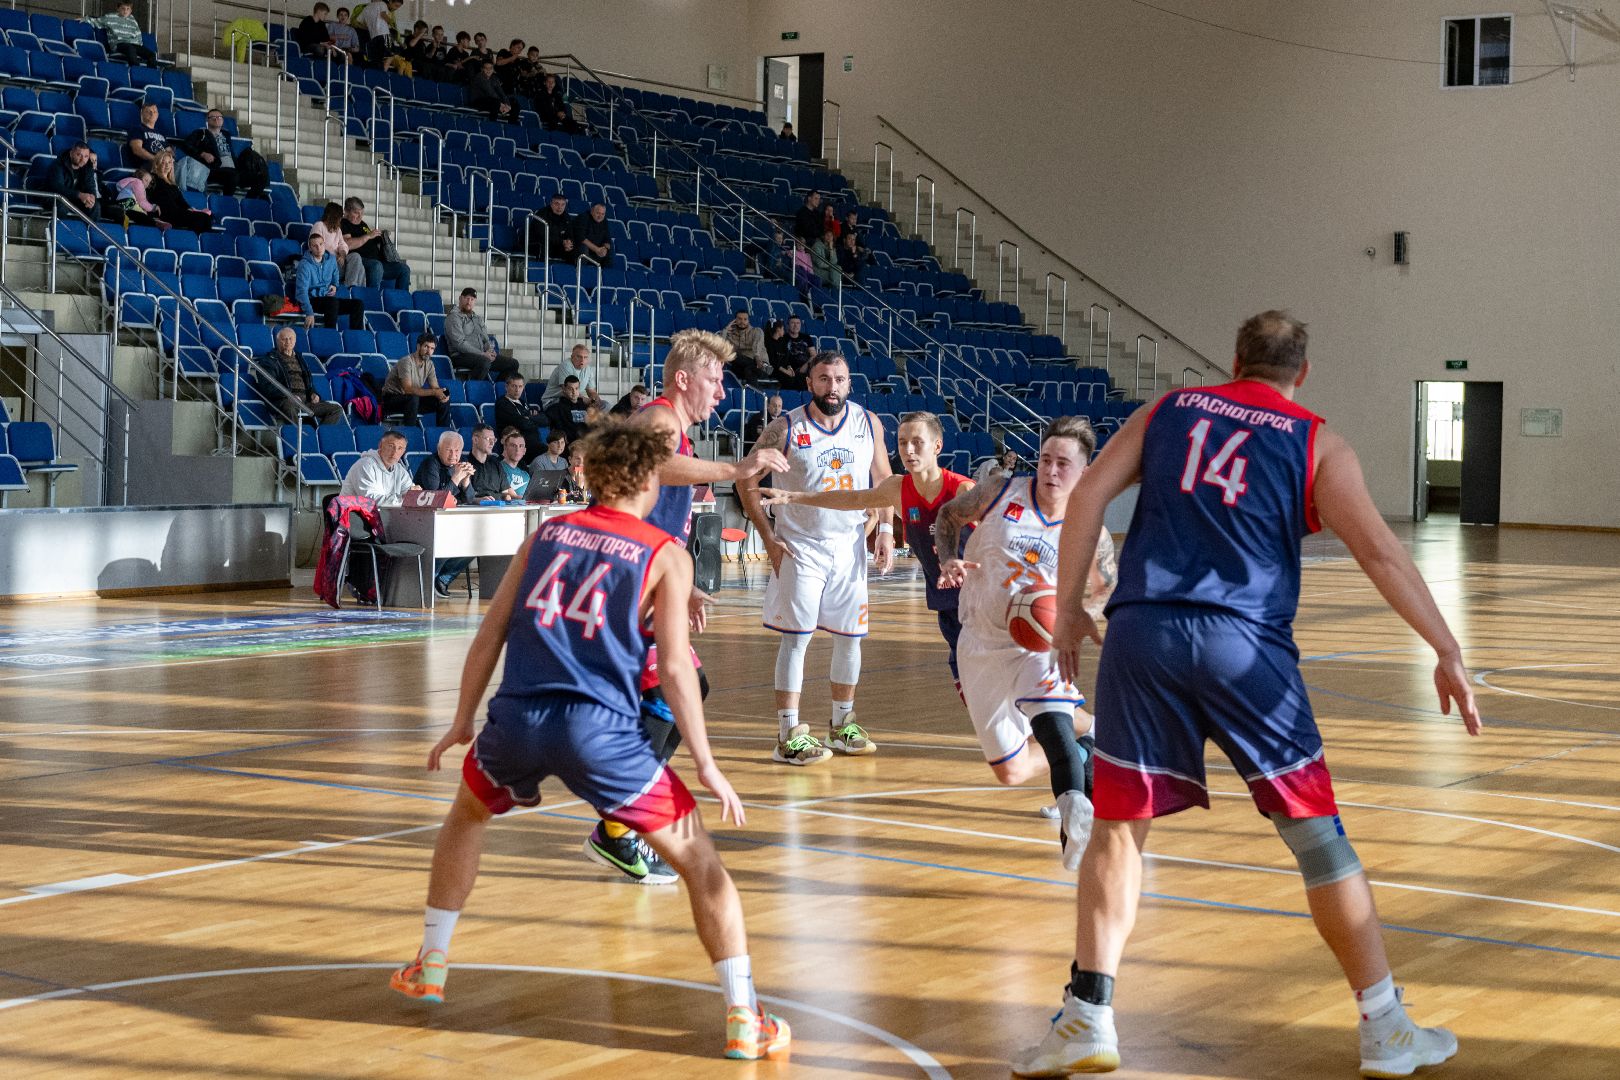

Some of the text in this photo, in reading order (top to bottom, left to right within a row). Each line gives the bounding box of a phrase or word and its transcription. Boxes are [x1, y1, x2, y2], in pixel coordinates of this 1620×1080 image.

[1175, 392, 1297, 433] КРАСНОГОРСК
[1181, 418, 1253, 507] 14
[416, 491, 436, 507] 5
[540, 525, 646, 564] КРАСНОГОРСК
[525, 551, 613, 640] 44
